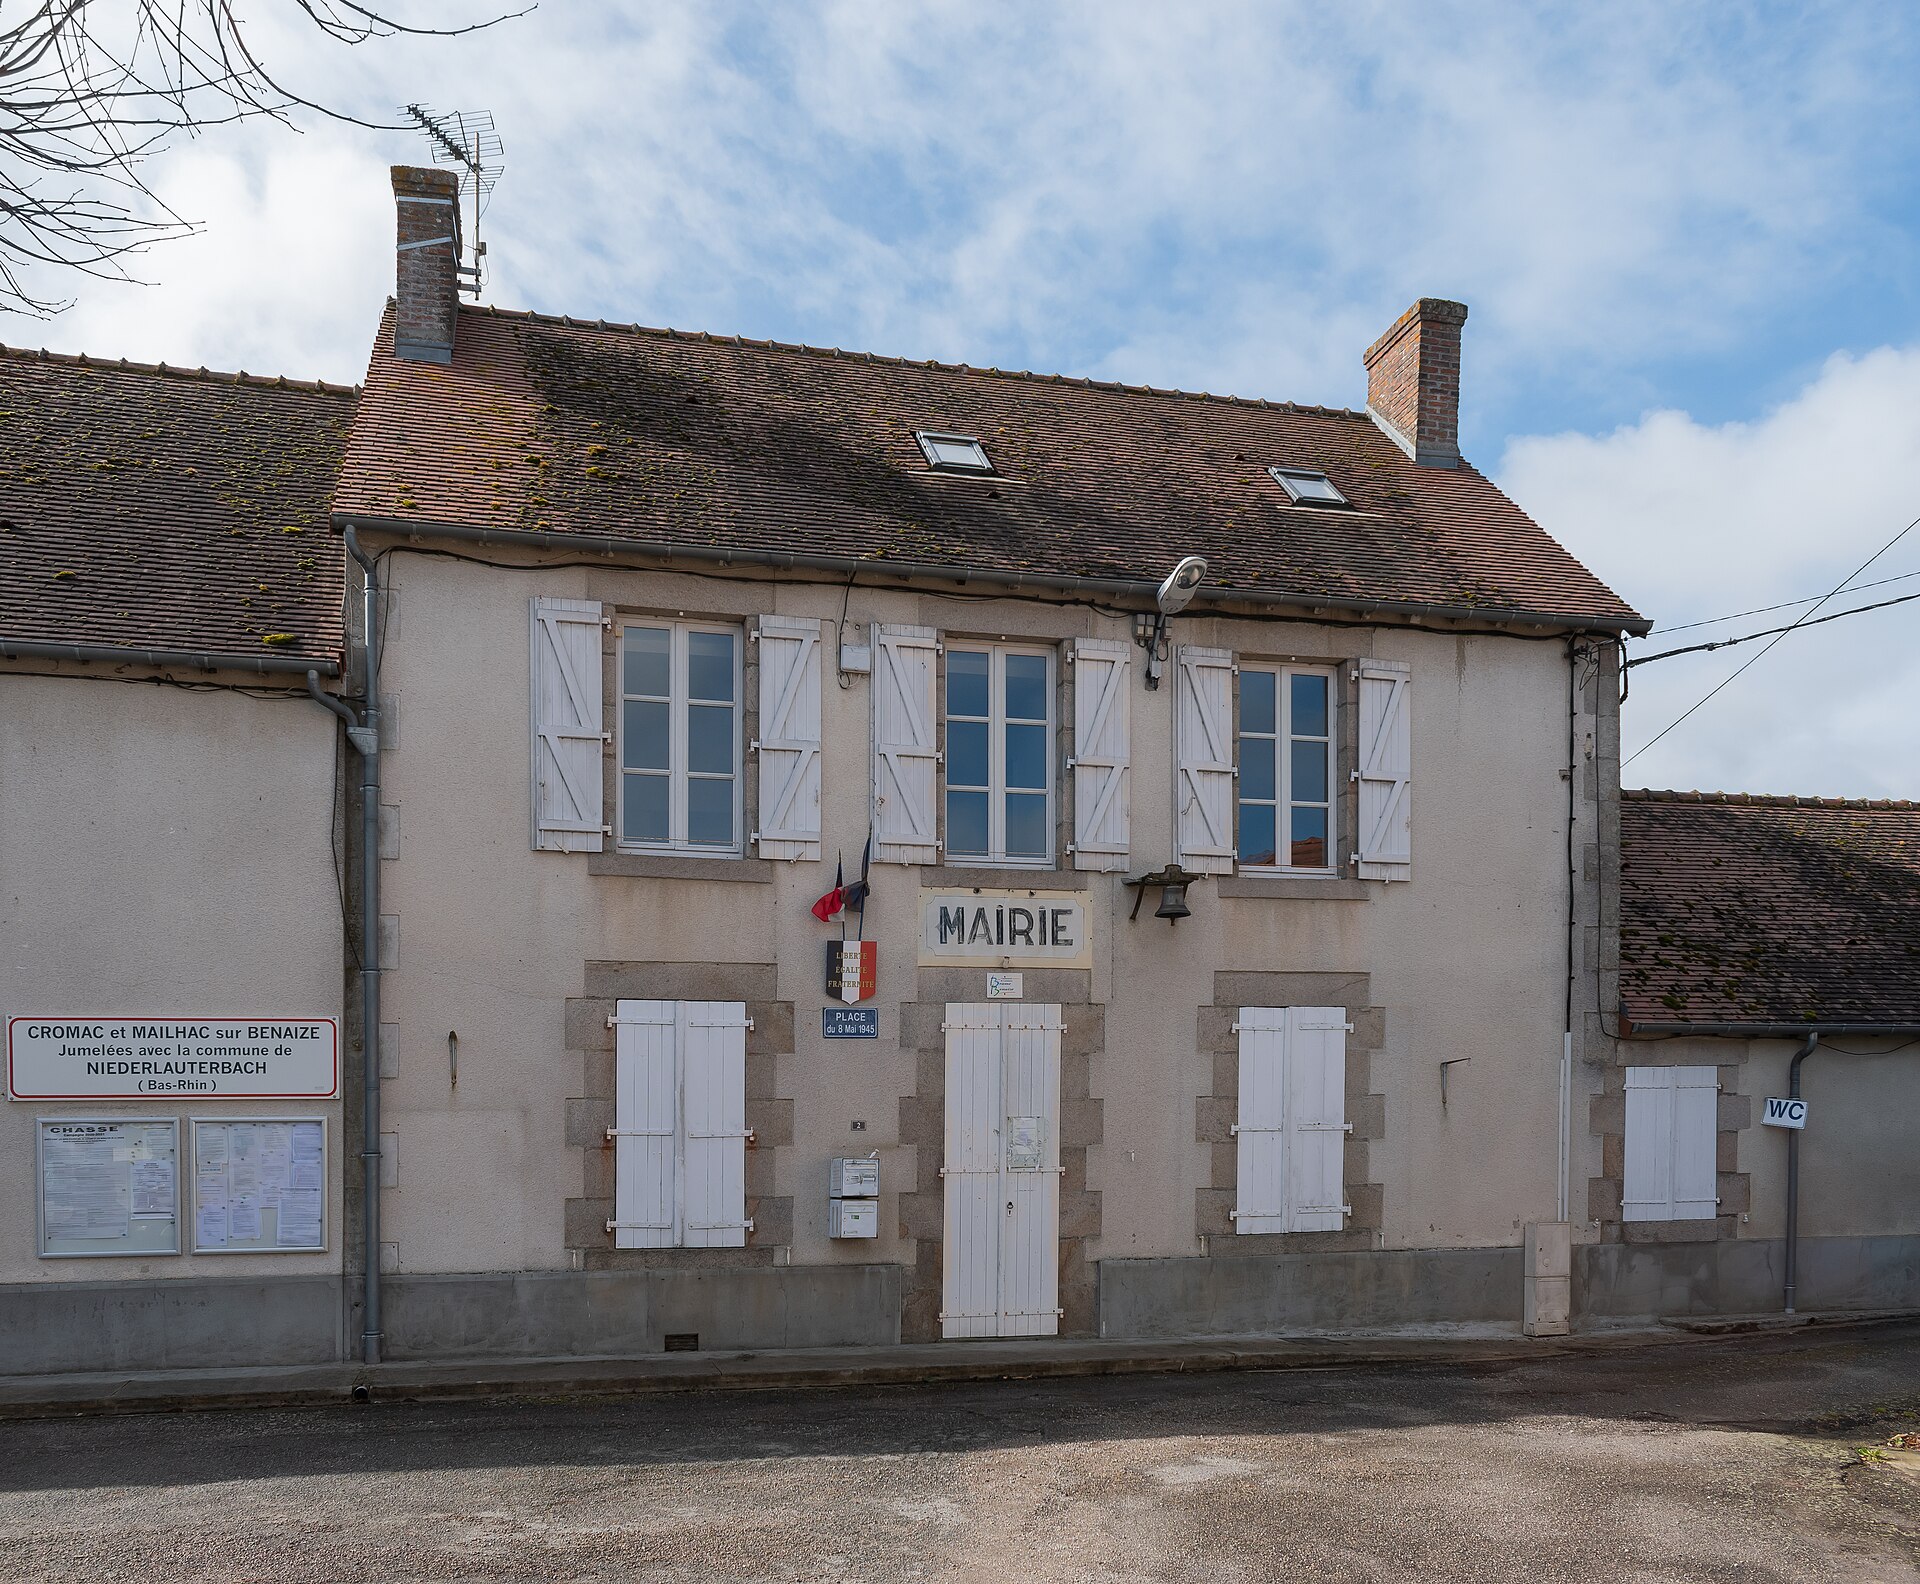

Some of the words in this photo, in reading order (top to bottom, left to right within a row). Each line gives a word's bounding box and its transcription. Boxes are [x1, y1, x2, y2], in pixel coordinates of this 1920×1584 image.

[939, 904, 1074, 946] MAIRIE
[835, 1012, 866, 1022] PLACE
[28, 1025, 104, 1039] CROMAC
[110, 1026, 127, 1039] et
[132, 1025, 211, 1040] MAILHAC
[215, 1028, 242, 1039] sur
[248, 1026, 321, 1040] BENAIZE
[826, 1024, 836, 1034] du
[837, 1024, 843, 1034] 8
[844, 1024, 857, 1034] Mai
[859, 1024, 875, 1034] 1945
[58, 1044, 133, 1057] Jumelées
[138, 1046, 171, 1057] avec
[177, 1044, 190, 1056] la
[196, 1046, 269, 1057] commune
[274, 1044, 292, 1056] de
[86, 1061, 268, 1075] NIEDERLAUTERBACH
[1769, 1100, 1805, 1121] WC
